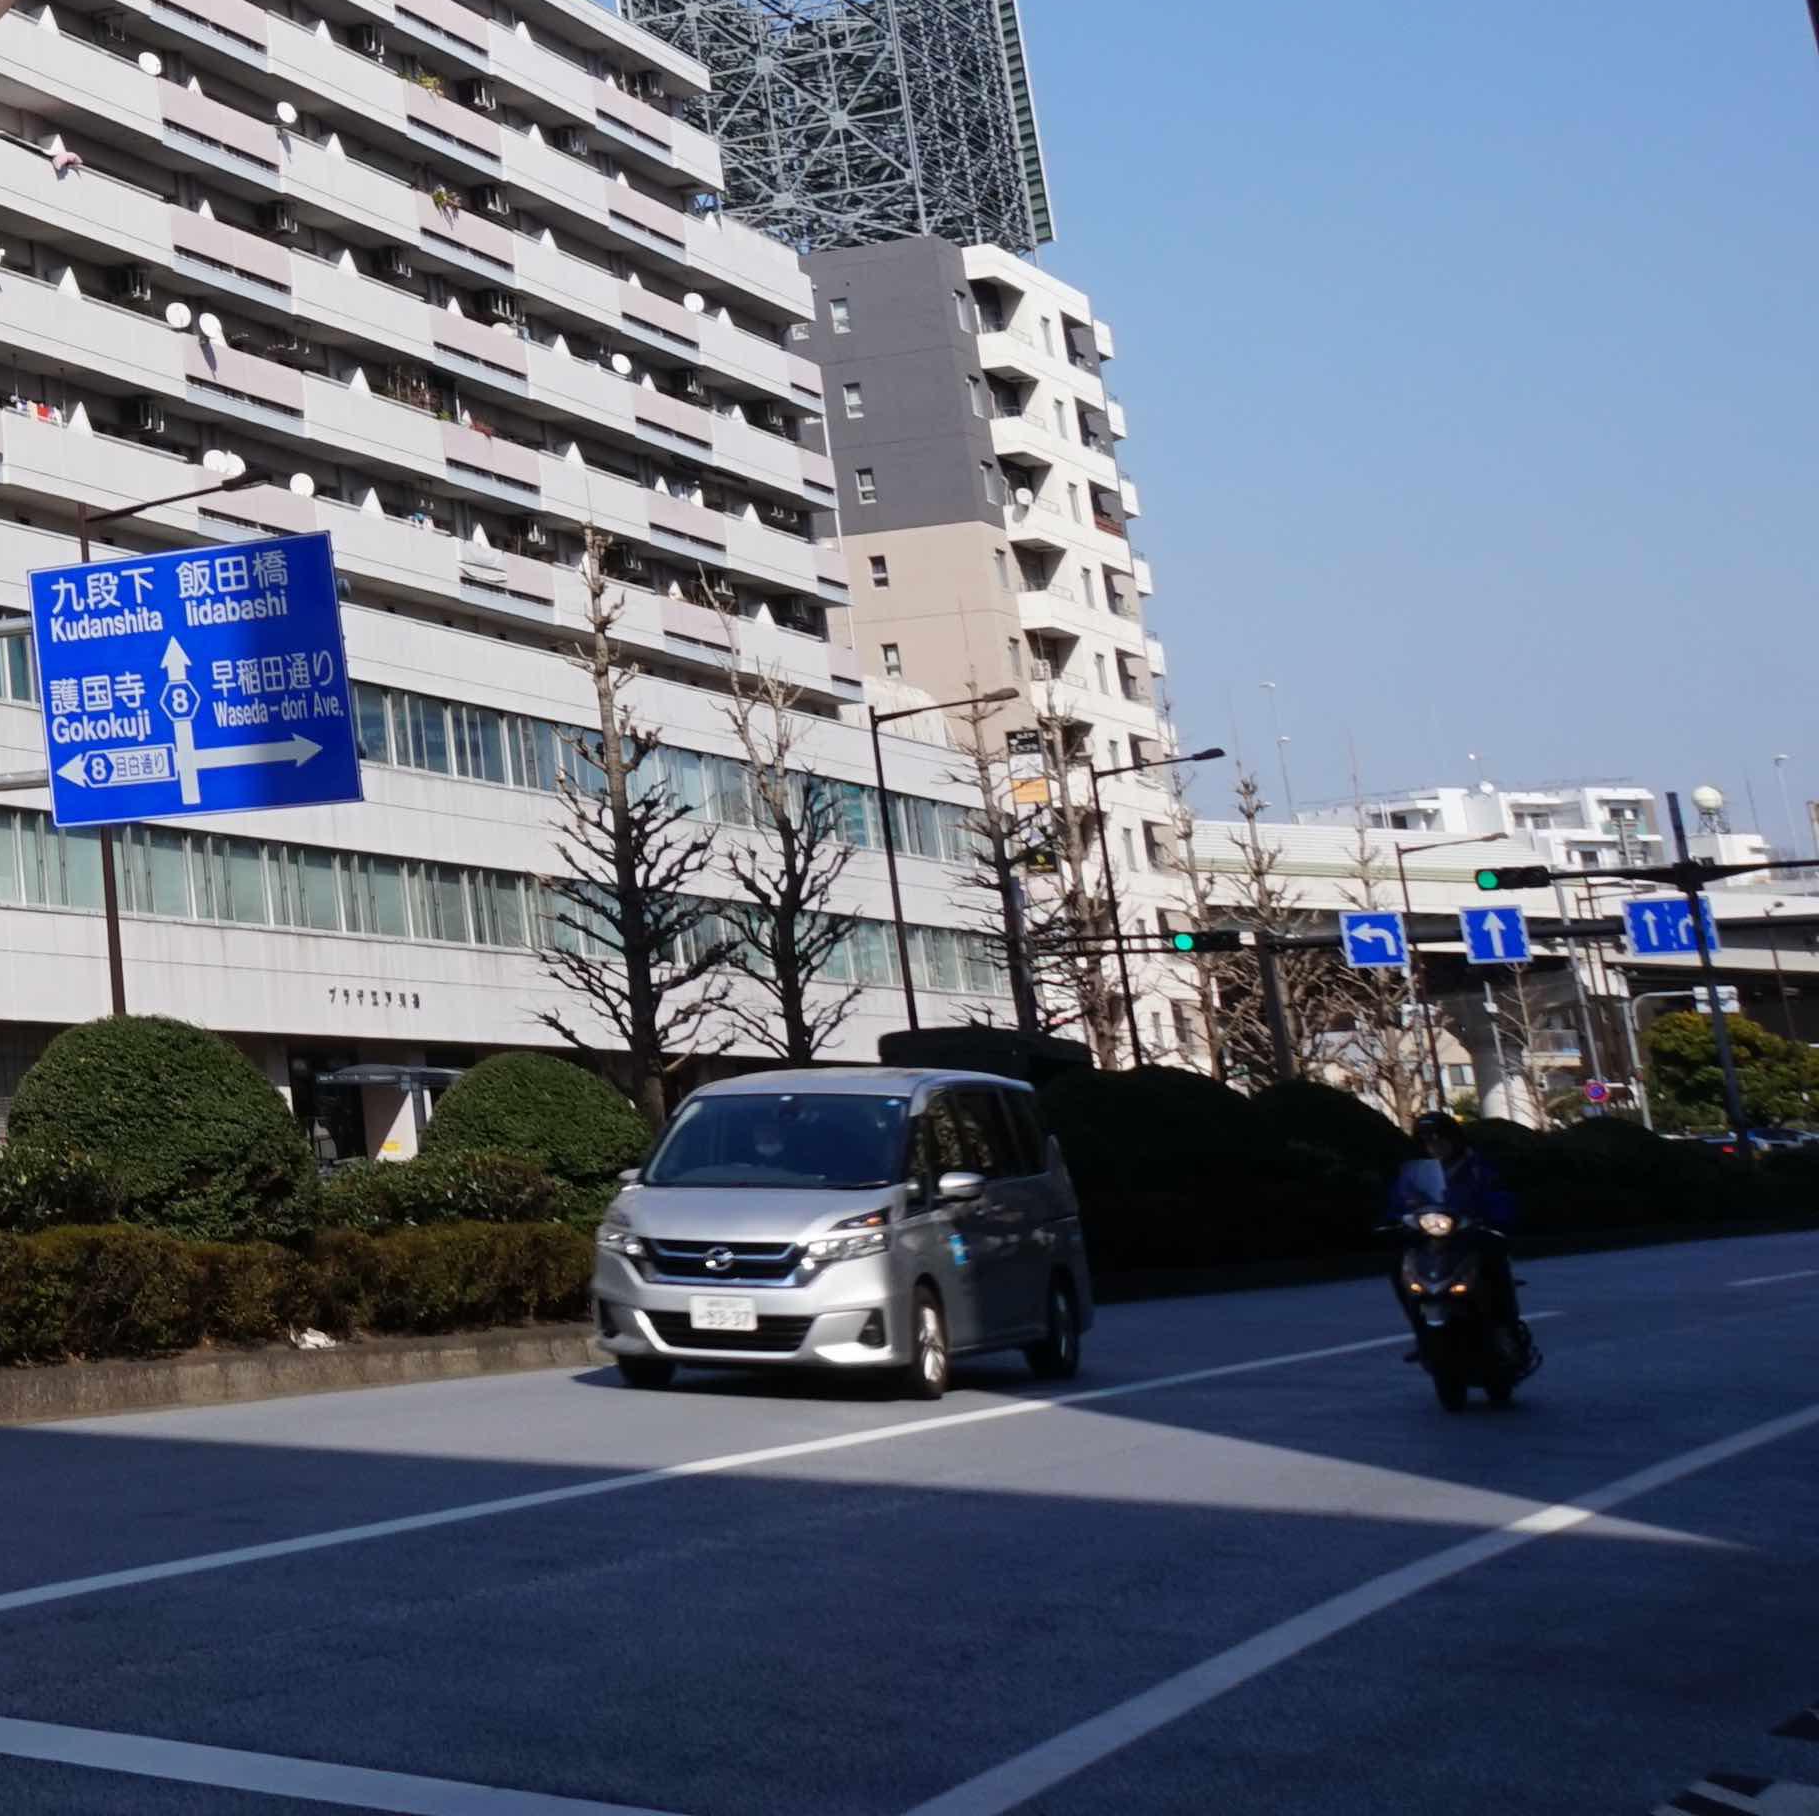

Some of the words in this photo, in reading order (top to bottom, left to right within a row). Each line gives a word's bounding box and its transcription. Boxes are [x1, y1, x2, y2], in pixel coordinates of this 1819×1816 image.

[51, 566, 155, 614] 九段下
[175, 550, 288, 599] 飯田橋
[50, 609, 163, 642] Kudanshita
[185, 591, 288, 626] Iidabashi
[211, 650, 333, 698] 早稲田通り
[50, 672, 145, 715] 護国寺
[172, 688, 189, 713] 8
[313, 692, 344, 717] Ave.
[52, 710, 150, 744] Gokokuji
[91, 757, 107, 780] 8
[115, 752, 164, 777] 目白通り
